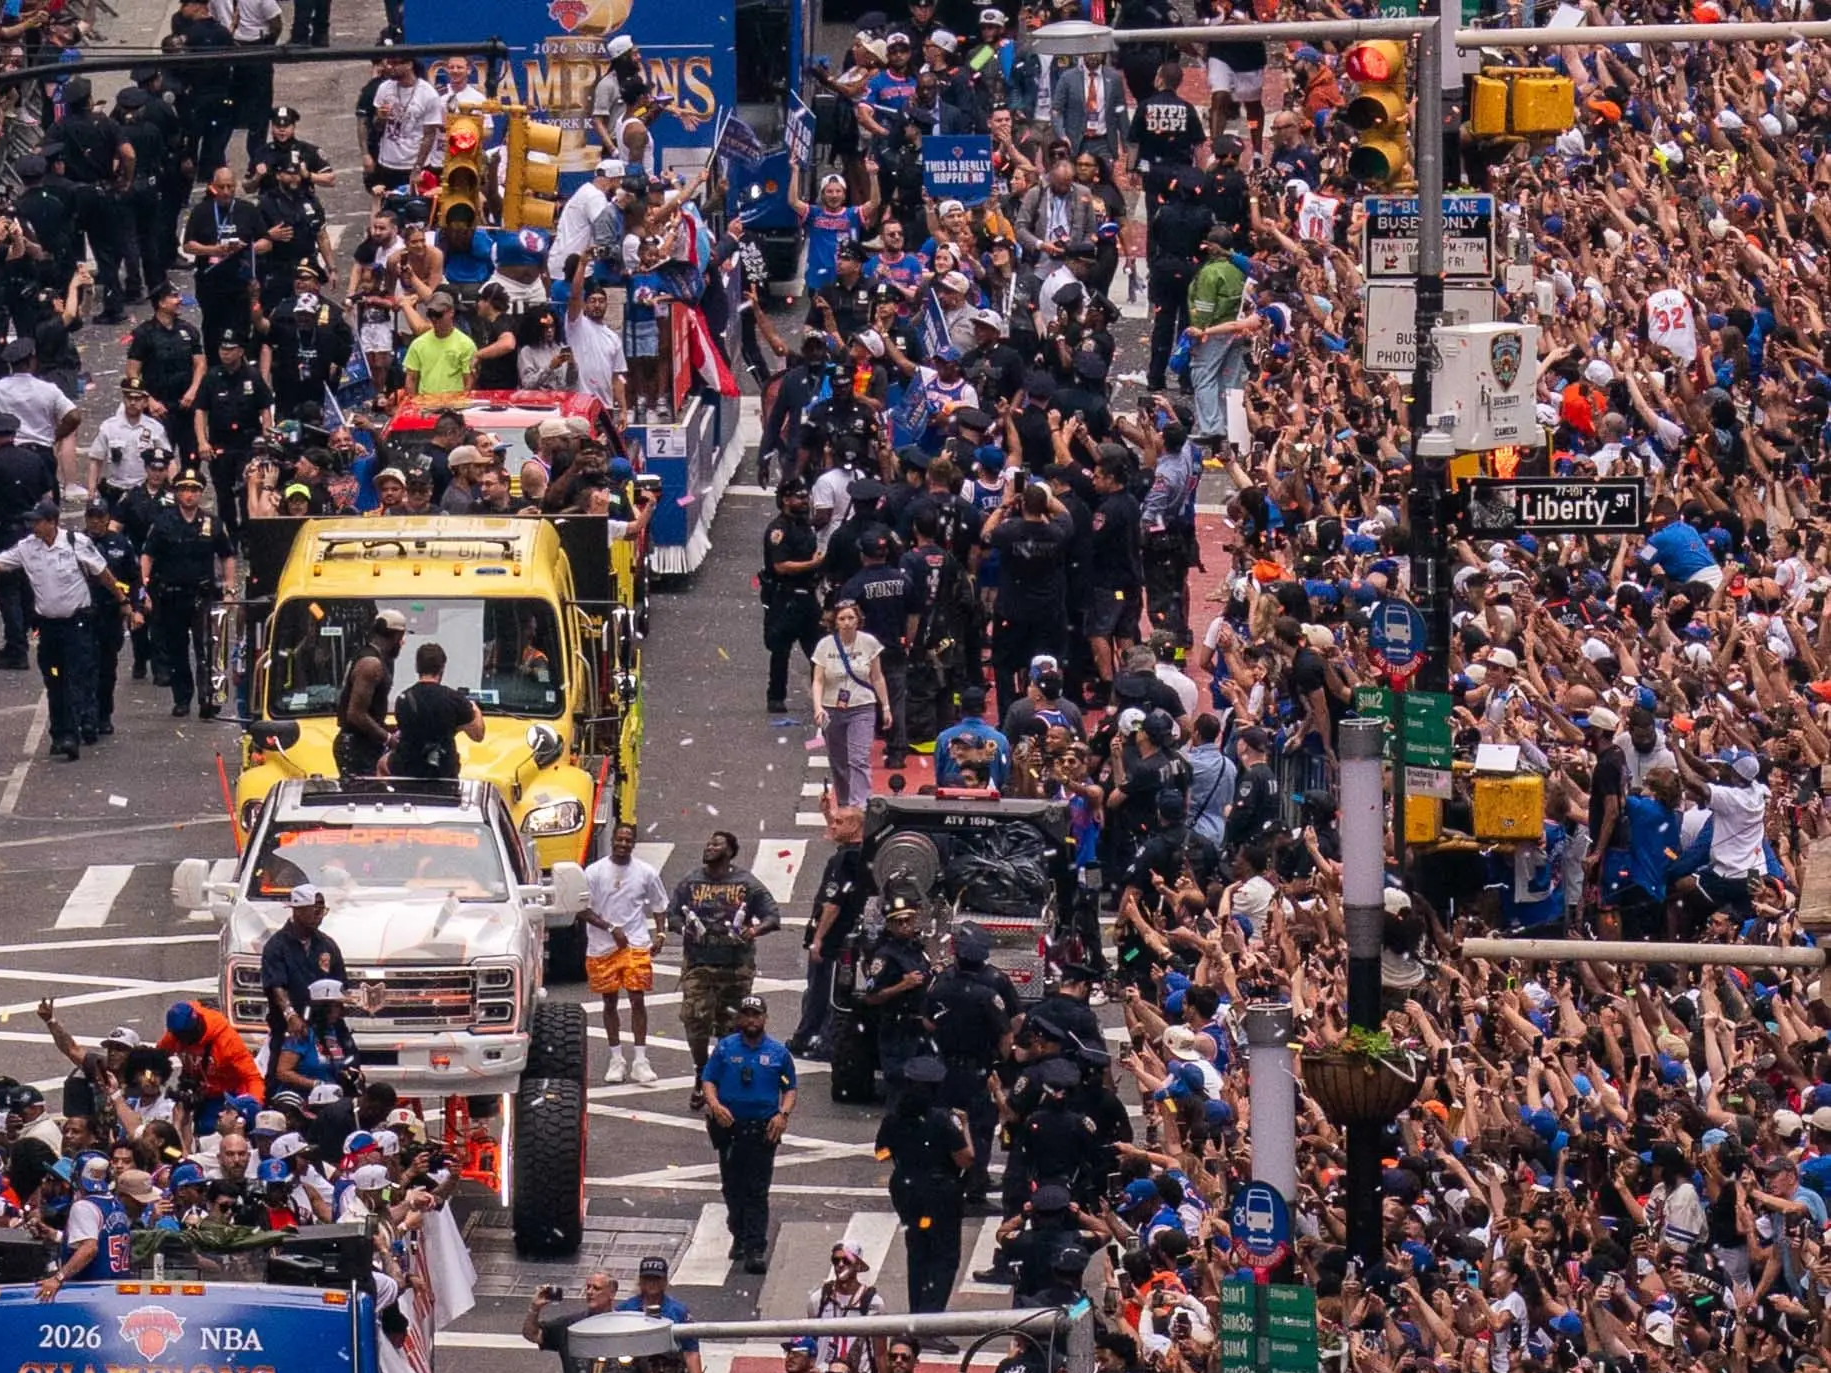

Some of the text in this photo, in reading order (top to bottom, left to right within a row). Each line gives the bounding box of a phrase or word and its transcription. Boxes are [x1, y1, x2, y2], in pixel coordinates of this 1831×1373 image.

[1146, 103, 1187, 118] NYPD
[1146, 118, 1187, 132] DCPI
[925, 160, 947, 172] THIS
[1401, 201, 1419, 214] BU
[1492, 395, 1521, 406] SECURITY
[1493, 426, 1519, 438] CAMERA
[657, 438, 666, 454] 2
[1521, 493, 1631, 527] Liberty ST
[863, 579, 905, 600] FDNY
[944, 815, 965, 826] ATV
[1222, 1286, 1246, 1304] SIM1
[1222, 1313, 1253, 1332] SIM3c
[38, 1324, 264, 1351] 2026 NBA
[1223, 1338, 1247, 1358] SIM4
